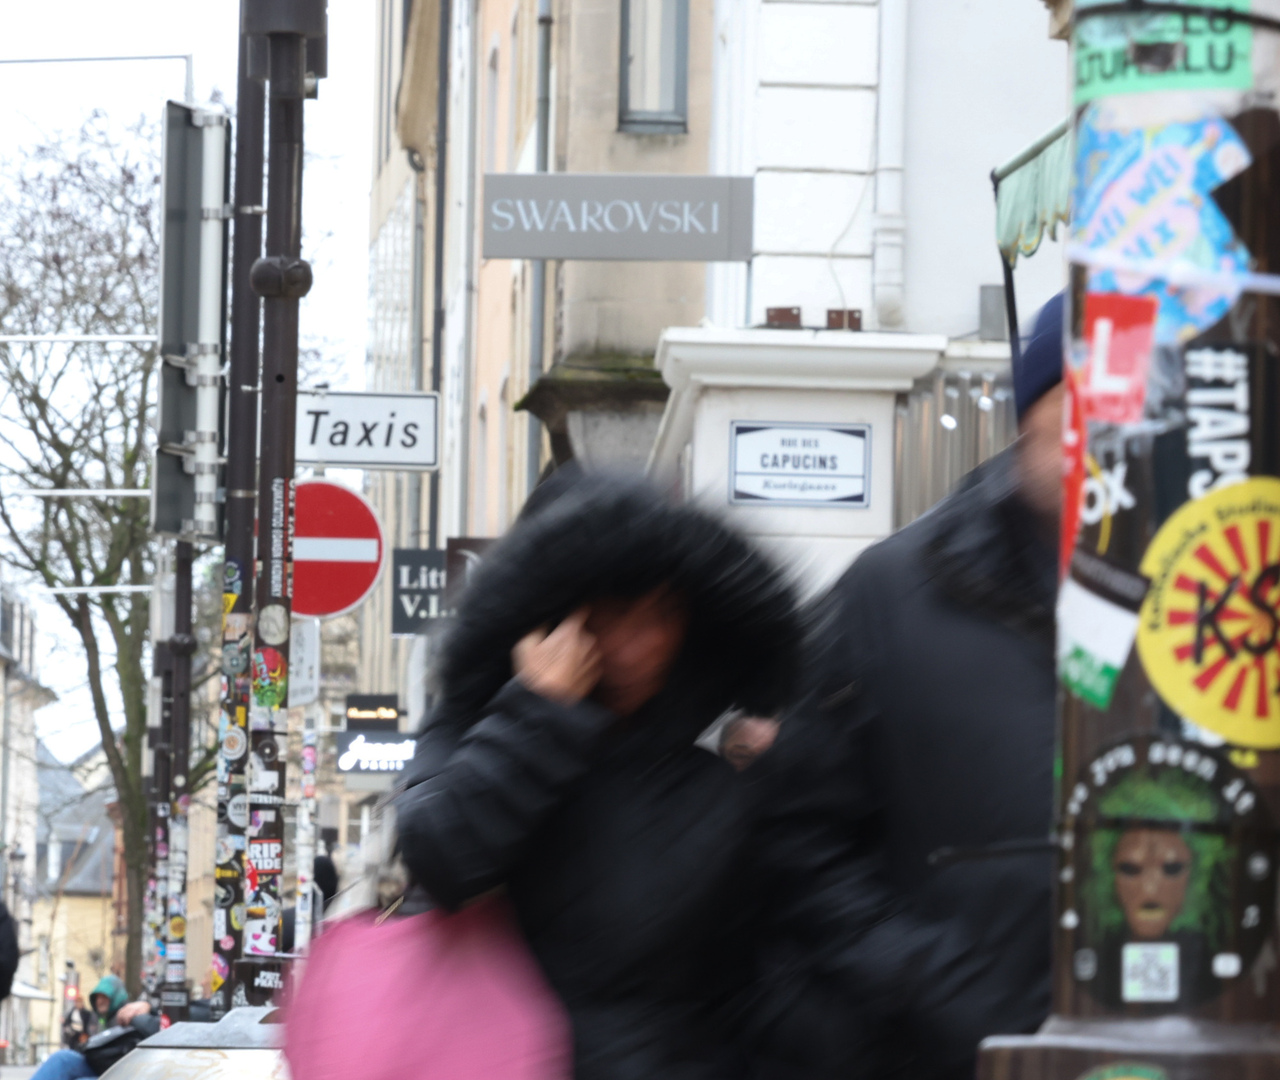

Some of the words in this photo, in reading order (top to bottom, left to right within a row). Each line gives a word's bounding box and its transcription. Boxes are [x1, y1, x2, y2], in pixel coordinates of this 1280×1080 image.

[491, 198, 718, 234] SWAROVSKI
[306, 410, 420, 448] Taxis
[760, 453, 838, 470] CAPUCINS
[250, 842, 282, 858] RIP
